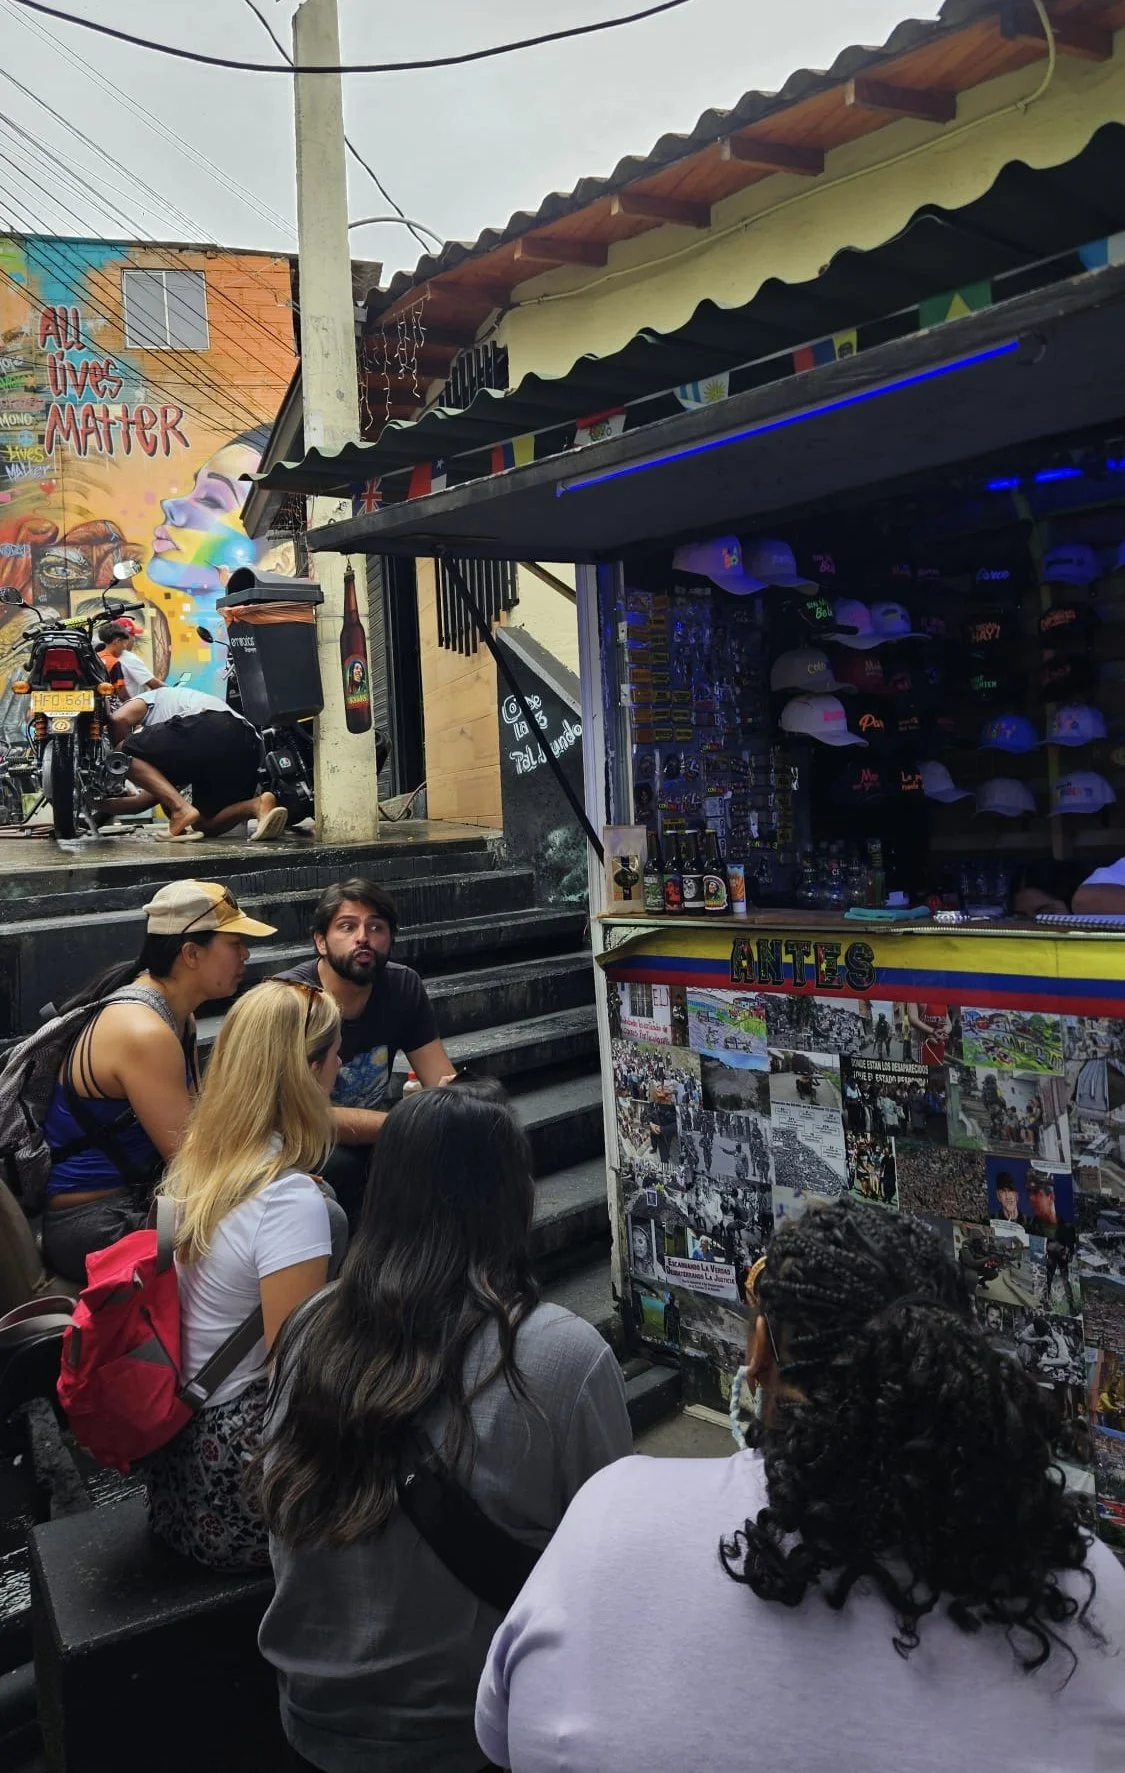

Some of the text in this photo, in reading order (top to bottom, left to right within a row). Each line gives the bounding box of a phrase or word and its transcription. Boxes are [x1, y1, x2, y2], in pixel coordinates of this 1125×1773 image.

[730, 937, 876, 992] ANTES
[867, 1060, 882, 1071] ESTAN
[882, 1061, 891, 1072] LOS
